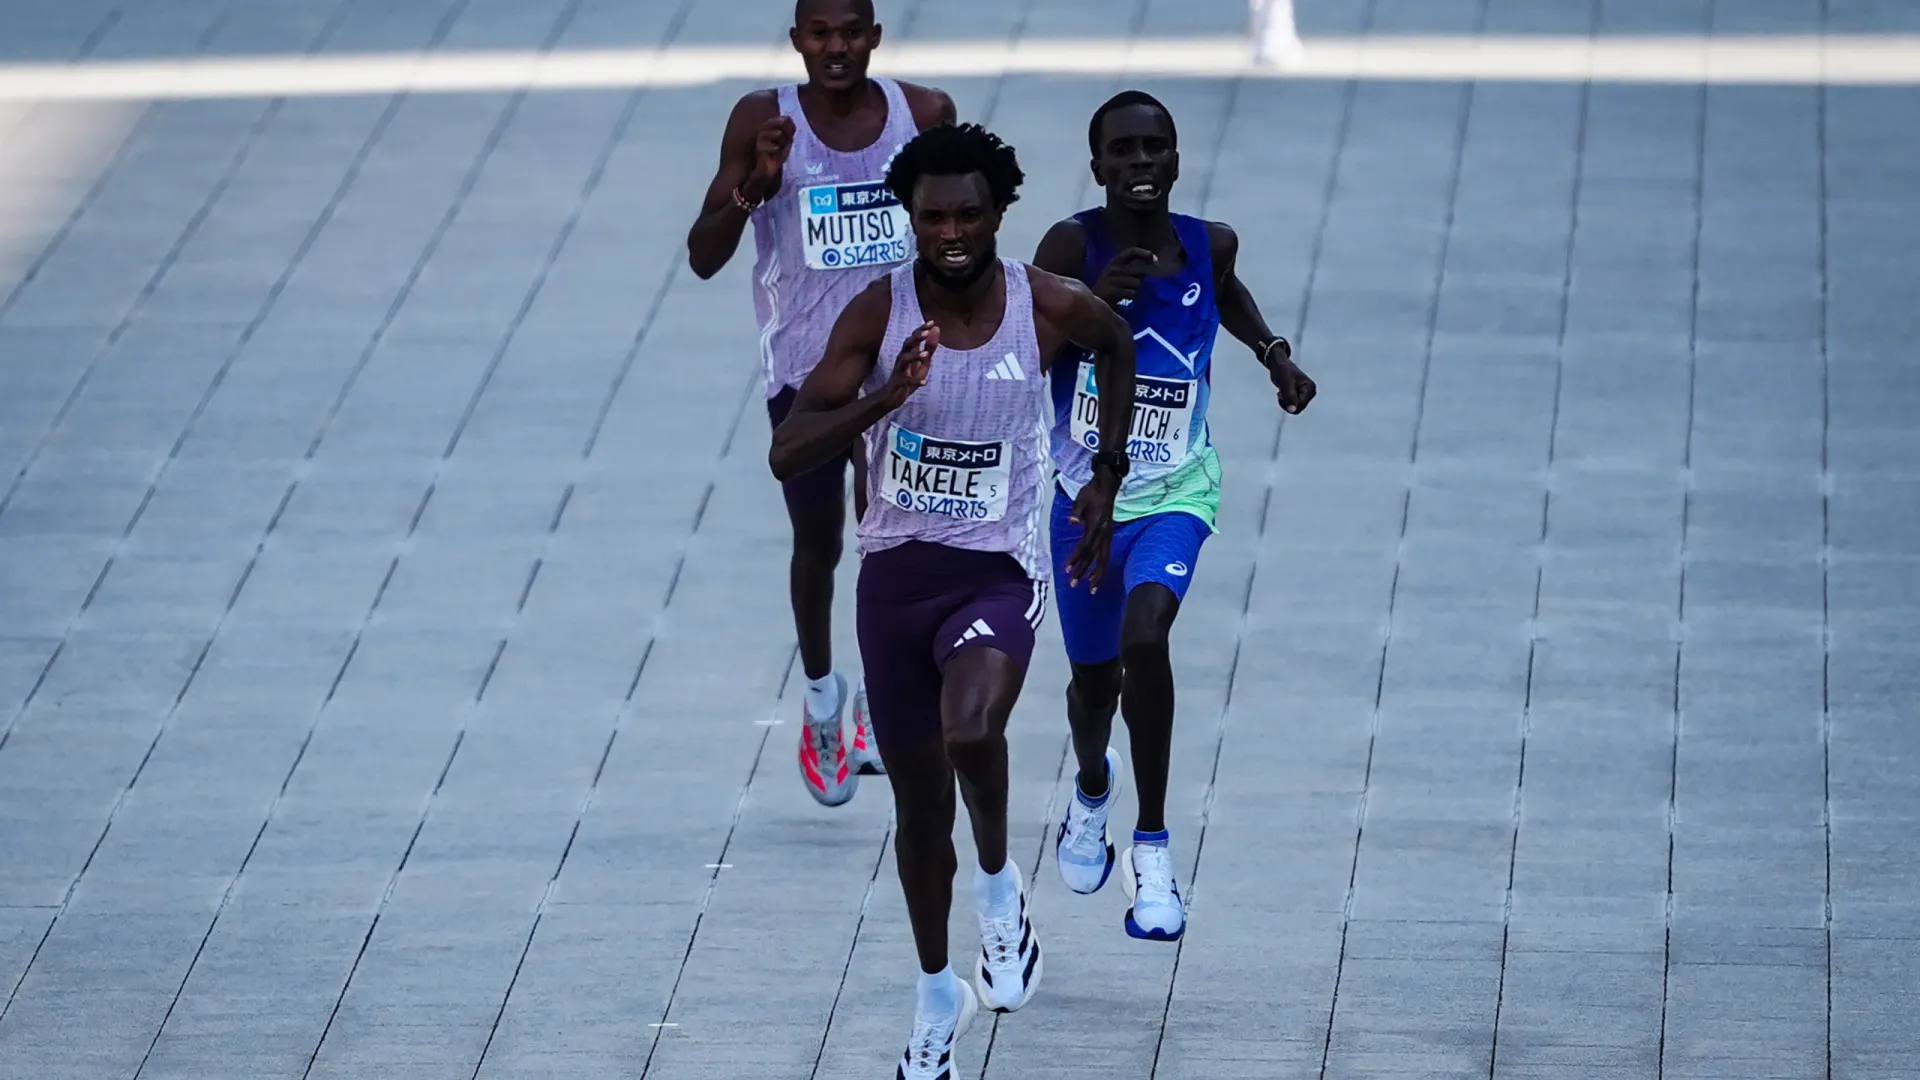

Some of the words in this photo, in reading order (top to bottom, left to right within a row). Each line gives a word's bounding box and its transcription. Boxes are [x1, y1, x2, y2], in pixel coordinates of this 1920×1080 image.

[807, 209, 895, 246] MUTISO
[1134, 384, 1185, 402] 京メトロ
[1077, 391, 1171, 440] TOTICH
[1172, 428, 1180, 441] 6
[925, 446, 997, 463] 東京メトロ
[890, 450, 982, 498] TAKELE
[989, 484, 997, 498] 5
